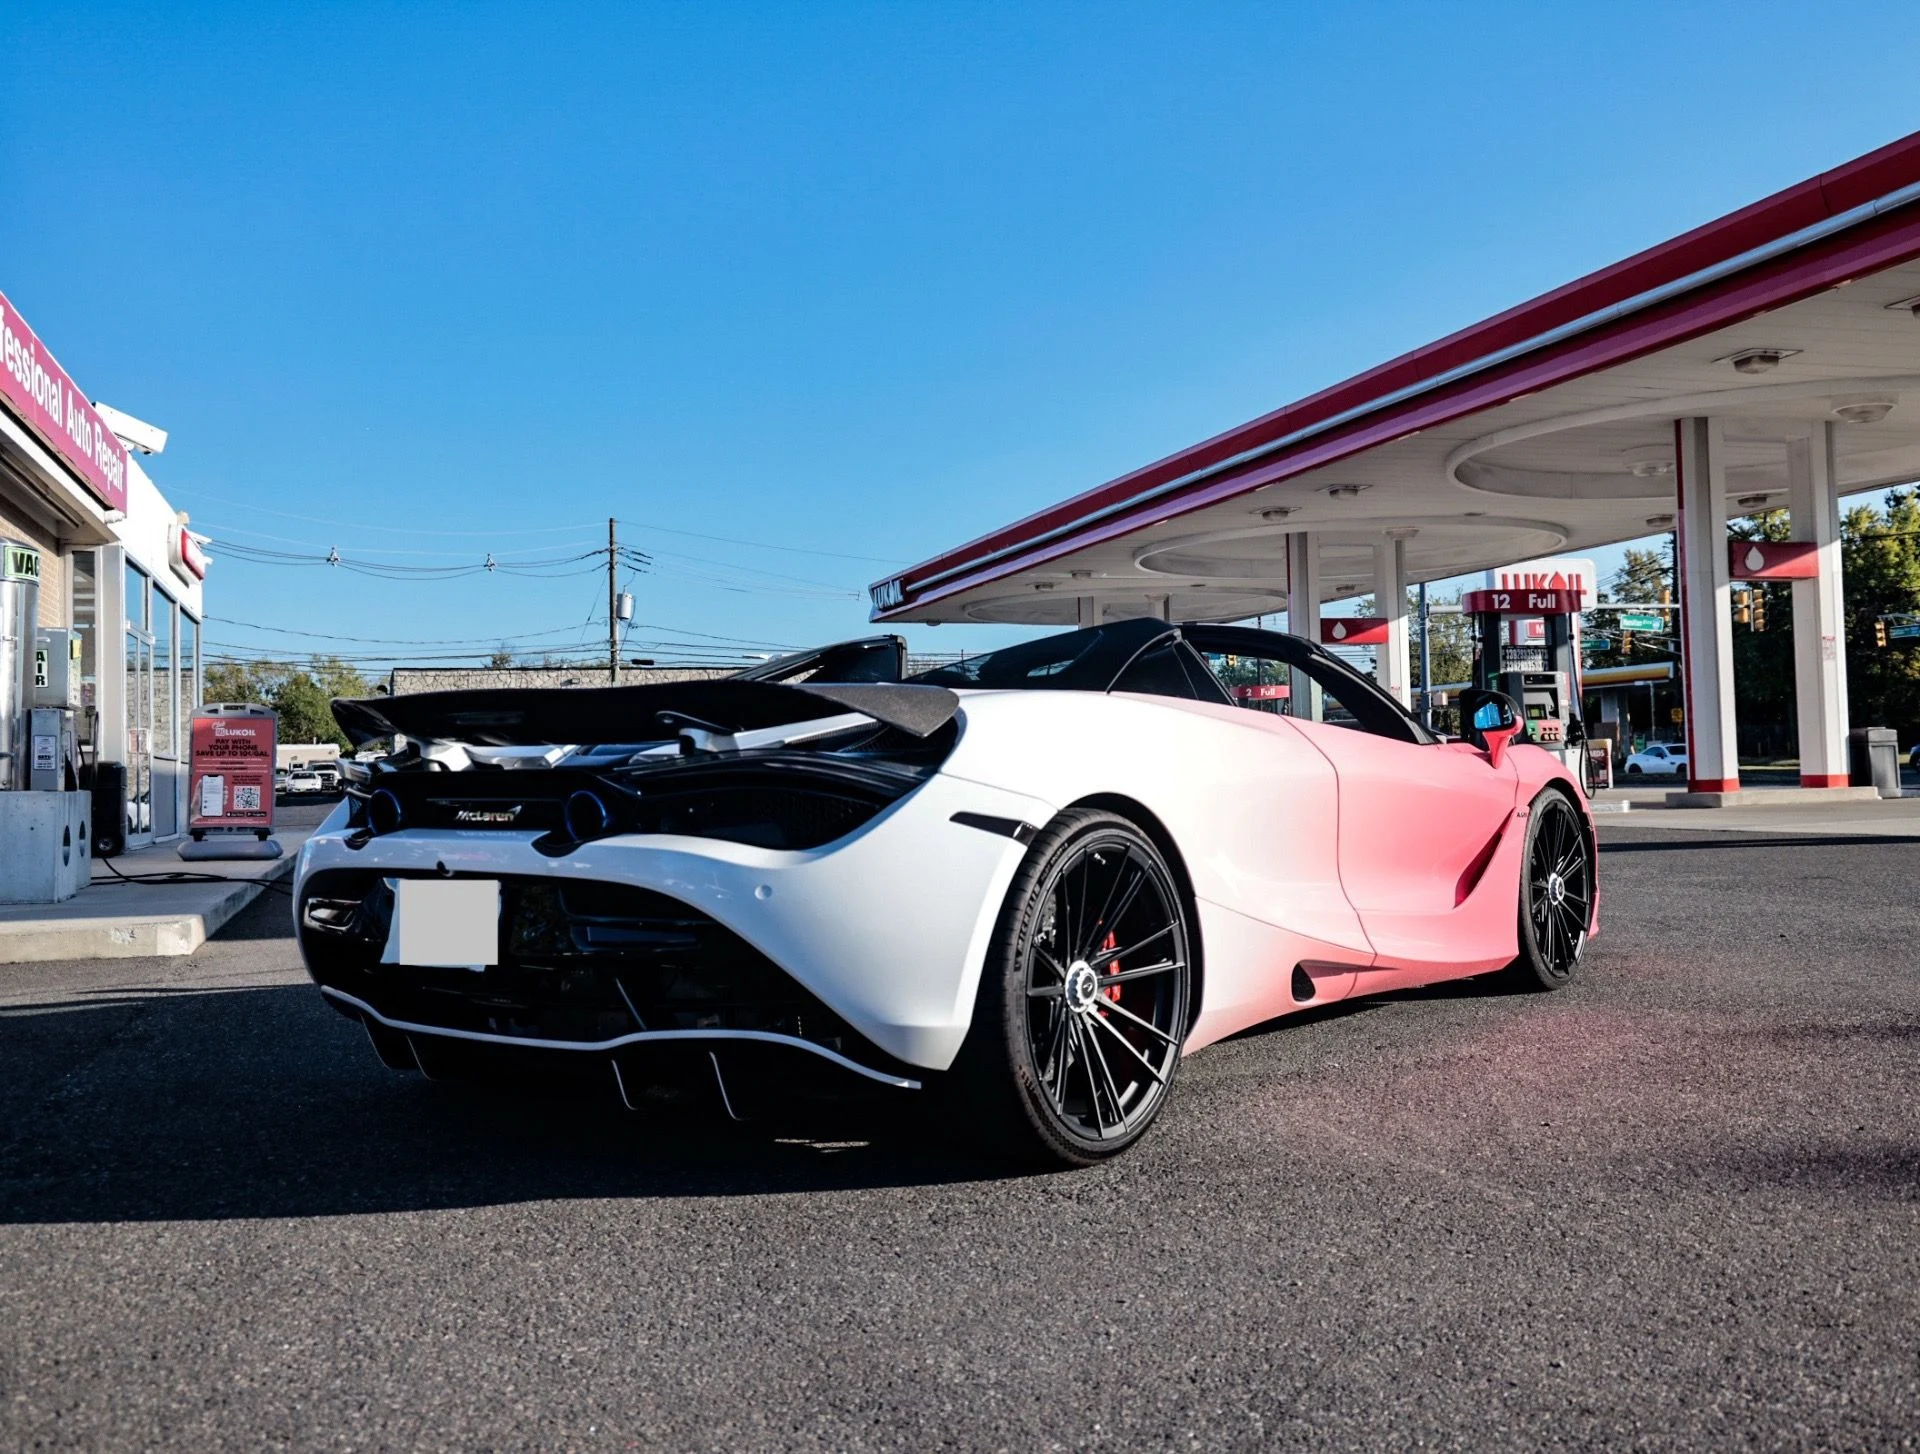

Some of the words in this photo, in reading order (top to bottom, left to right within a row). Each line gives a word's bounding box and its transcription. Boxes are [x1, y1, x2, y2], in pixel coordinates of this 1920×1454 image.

[66, 390, 92, 458] Auto
[95, 421, 123, 492] Repair
[1492, 594, 1510, 608] 12
[1528, 594, 1556, 608] Full
[35, 651, 45, 685] AIR
[1260, 688, 1275, 696] Full
[456, 810, 514, 821] McLaren
